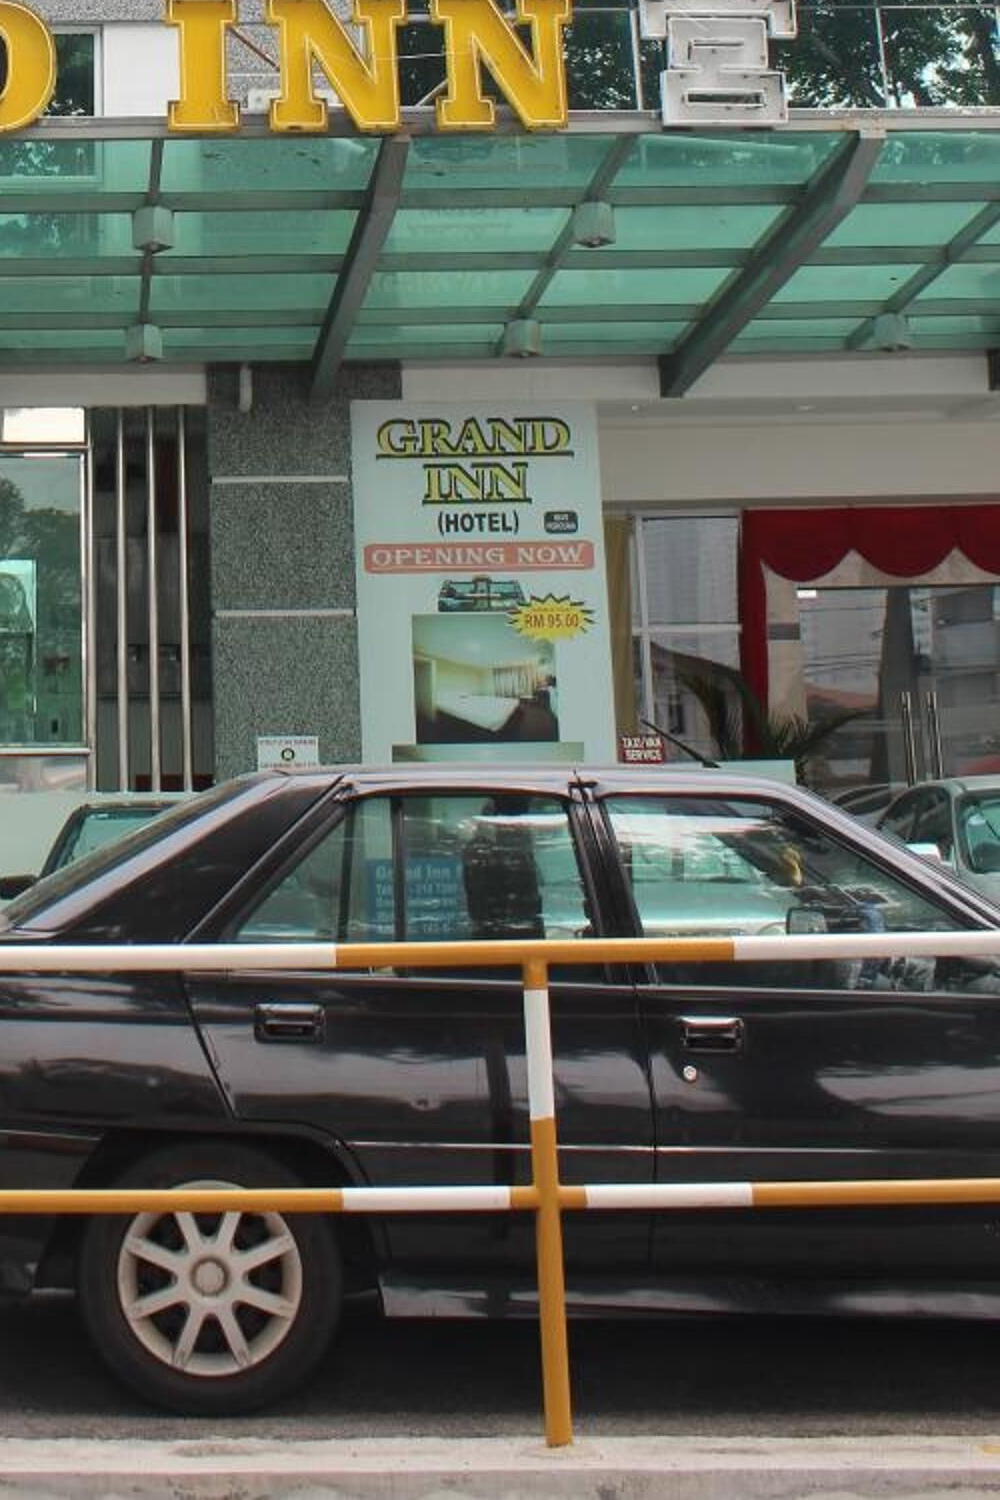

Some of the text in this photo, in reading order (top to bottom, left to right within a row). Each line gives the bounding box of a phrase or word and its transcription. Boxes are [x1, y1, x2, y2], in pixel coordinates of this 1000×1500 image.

[376, 416, 573, 457] GRAND
[422, 462, 531, 503] INN
[437, 509, 520, 536] (HOTEL)
[371, 542, 587, 567] OPENING NOW
[524, 613, 545, 629] RM
